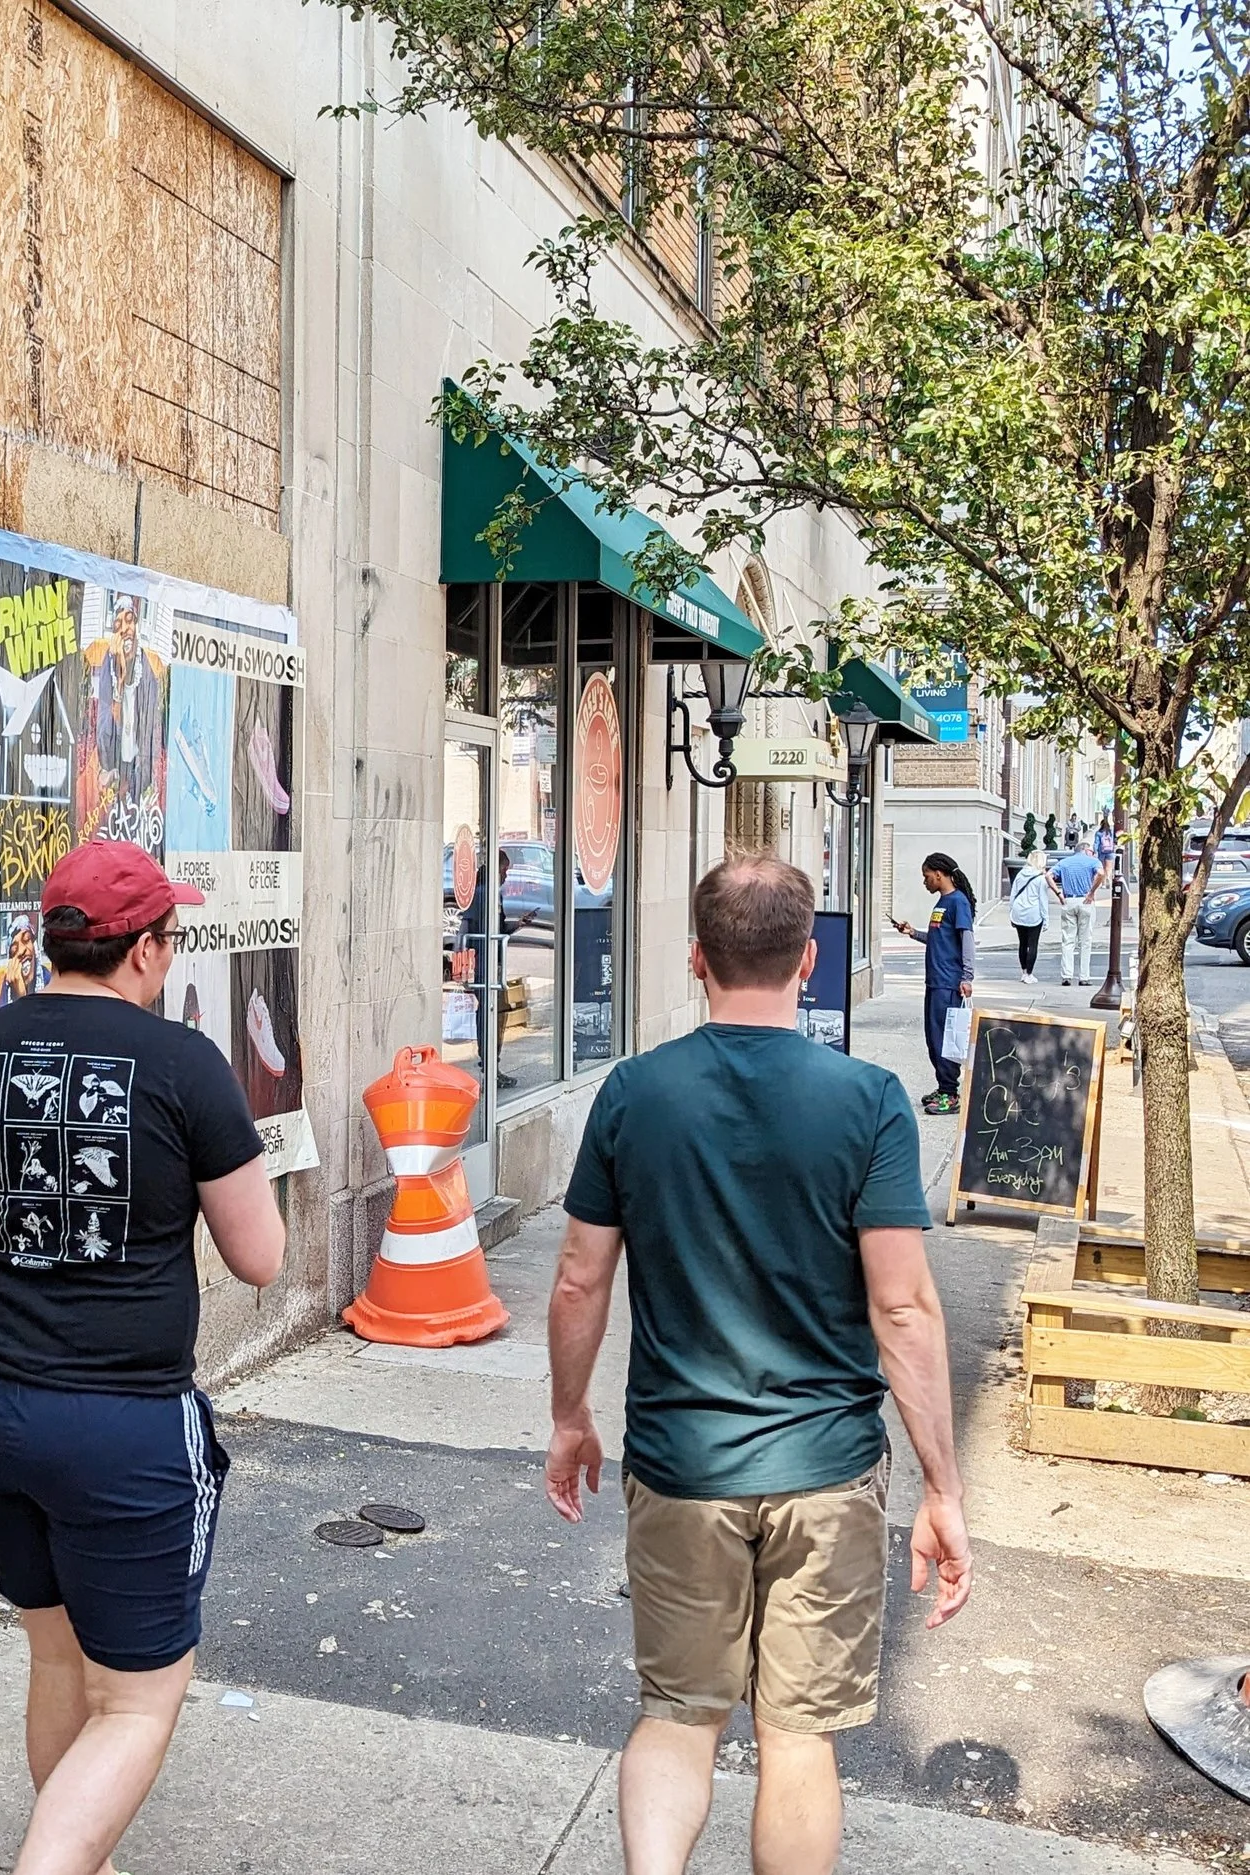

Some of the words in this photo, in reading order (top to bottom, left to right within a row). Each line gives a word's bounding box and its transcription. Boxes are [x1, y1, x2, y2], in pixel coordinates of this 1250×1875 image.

[5, 615, 78, 678] WHITE
[916, 689, 947, 697] LIVING
[936, 714, 963, 722] 4078
[899, 743, 973, 751] RIVERLOFT
[772, 751, 805, 765] 2220
[176, 862, 183, 876] A
[184, 861, 210, 876] FORCE
[250, 861, 255, 874] A
[256, 860, 280, 874] FORCE
[184, 877, 216, 892] ANTASY.
[33, 901, 42, 911] EV
[173, 923, 228, 954] WOOSH
[237, 918, 301, 947] SWOOSH
[262, 1138, 285, 1156] PORT.
